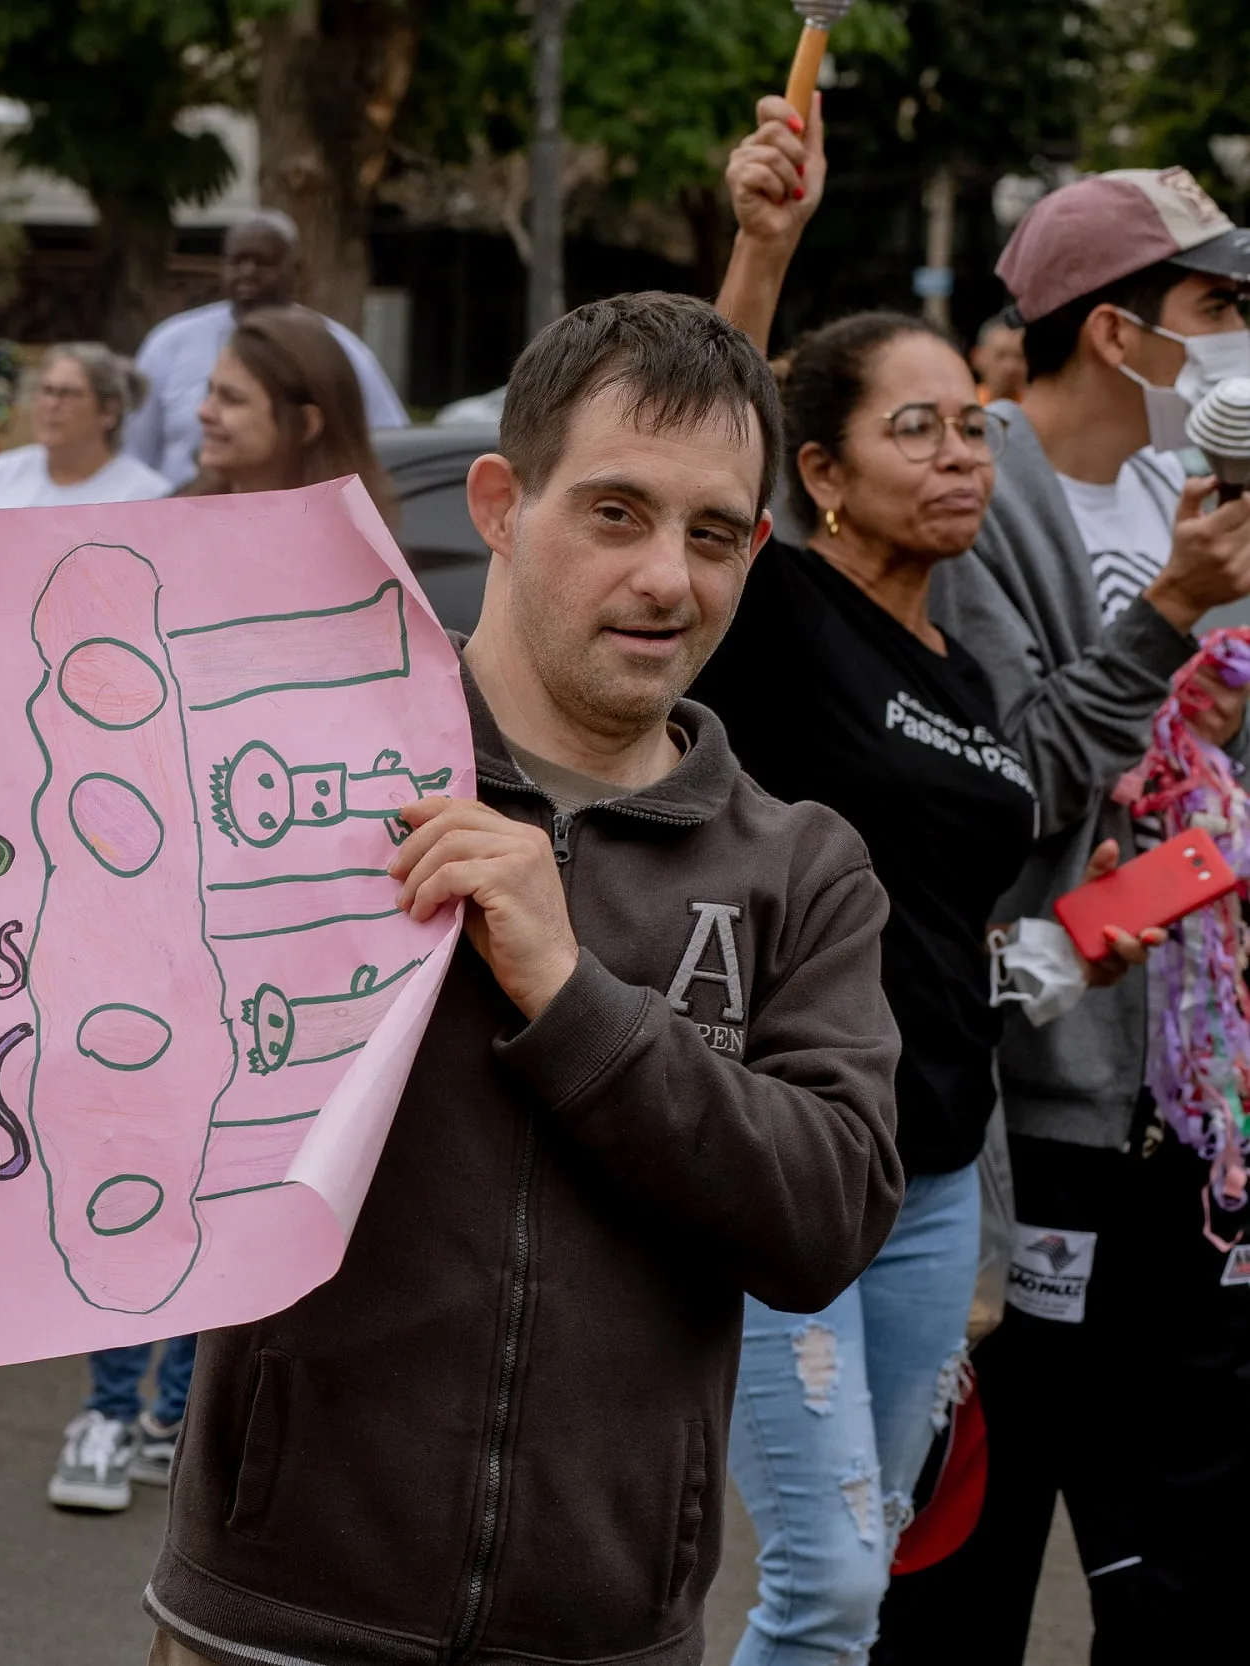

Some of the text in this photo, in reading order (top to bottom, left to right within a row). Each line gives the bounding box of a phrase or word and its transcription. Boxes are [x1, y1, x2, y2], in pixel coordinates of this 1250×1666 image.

[886, 699, 961, 756] Passo
[964, 745, 982, 766] a
[666, 901, 744, 1022] A
